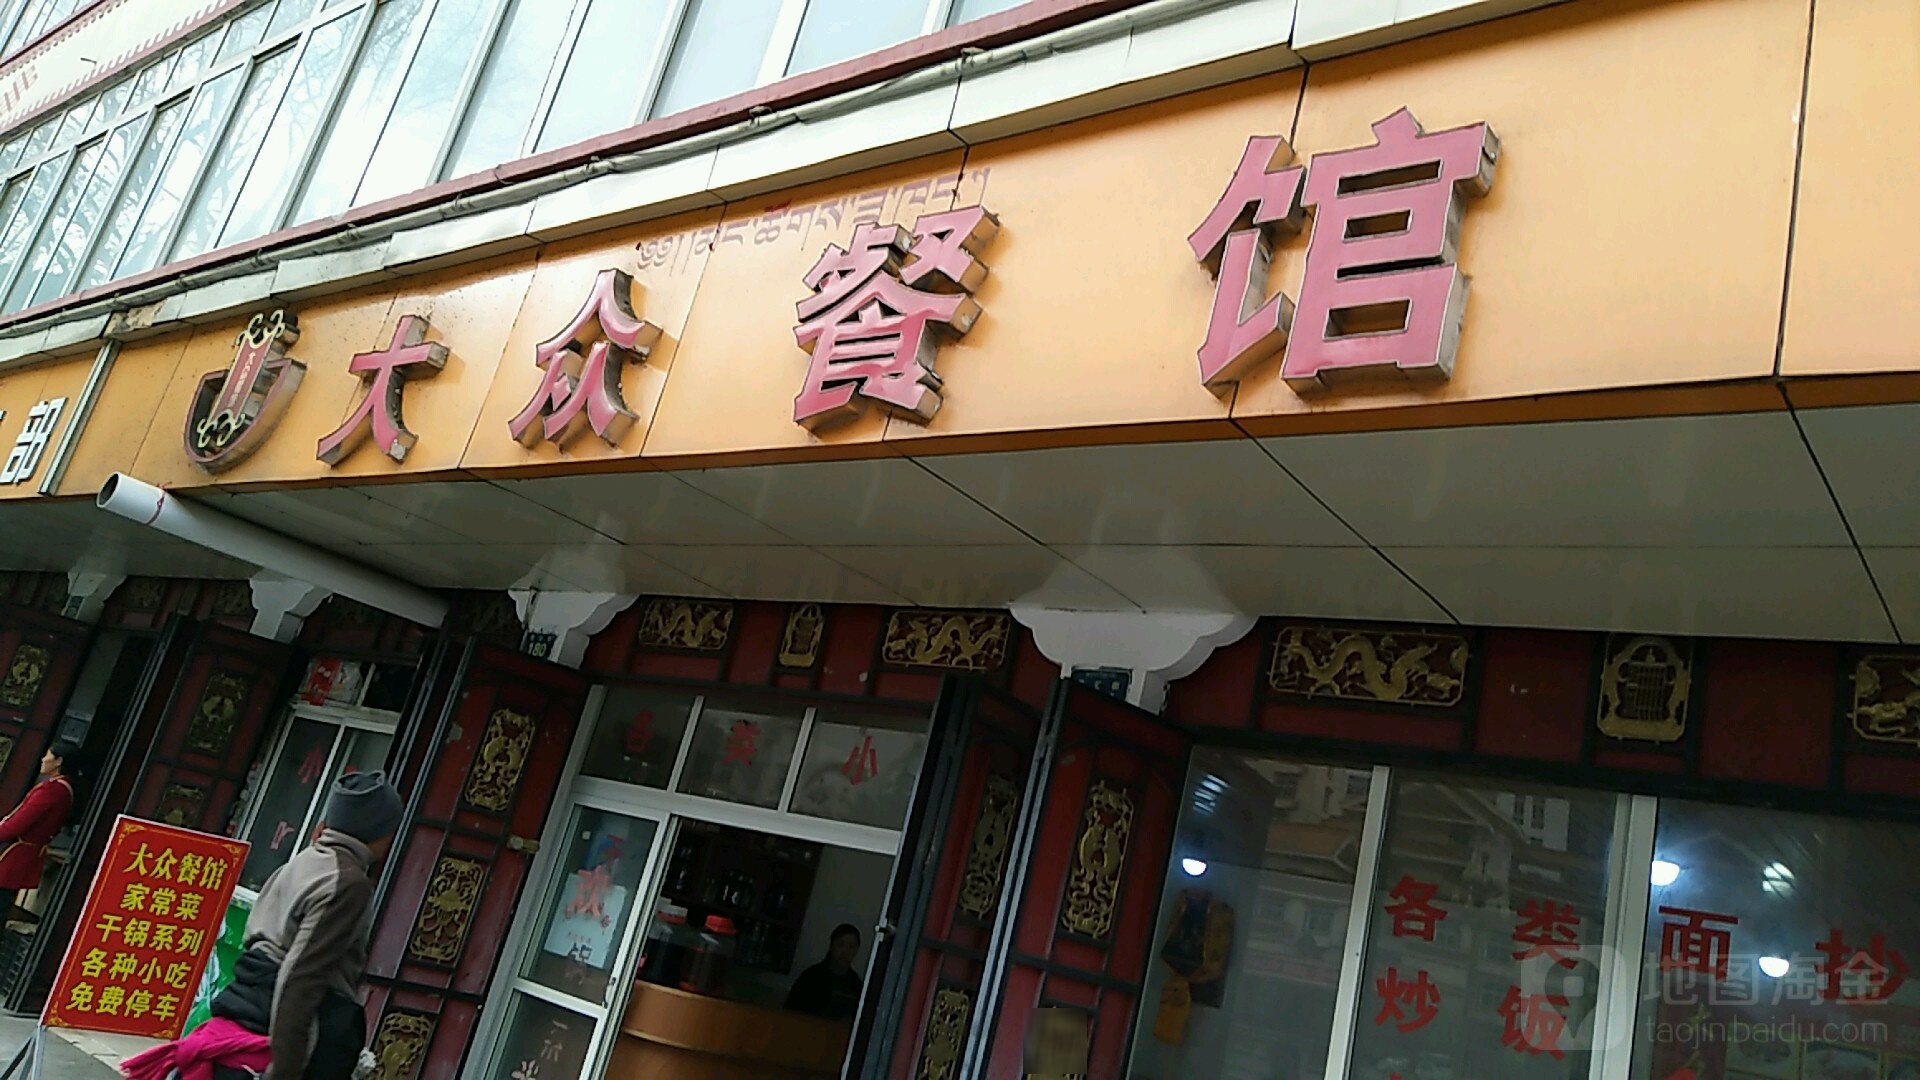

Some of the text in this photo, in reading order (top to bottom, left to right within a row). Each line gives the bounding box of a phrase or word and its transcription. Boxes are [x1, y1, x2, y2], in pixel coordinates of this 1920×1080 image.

[317, 107, 1491, 463] 大众餐馆
[0, 397, 67, 484] 部
[123, 843, 229, 891] 大众餐馆
[120, 883, 204, 920] 家常菜
[95, 914, 205, 956] 干锅系列
[81, 948, 192, 990] 各种小吃
[65, 982, 181, 1022] 免费停车
